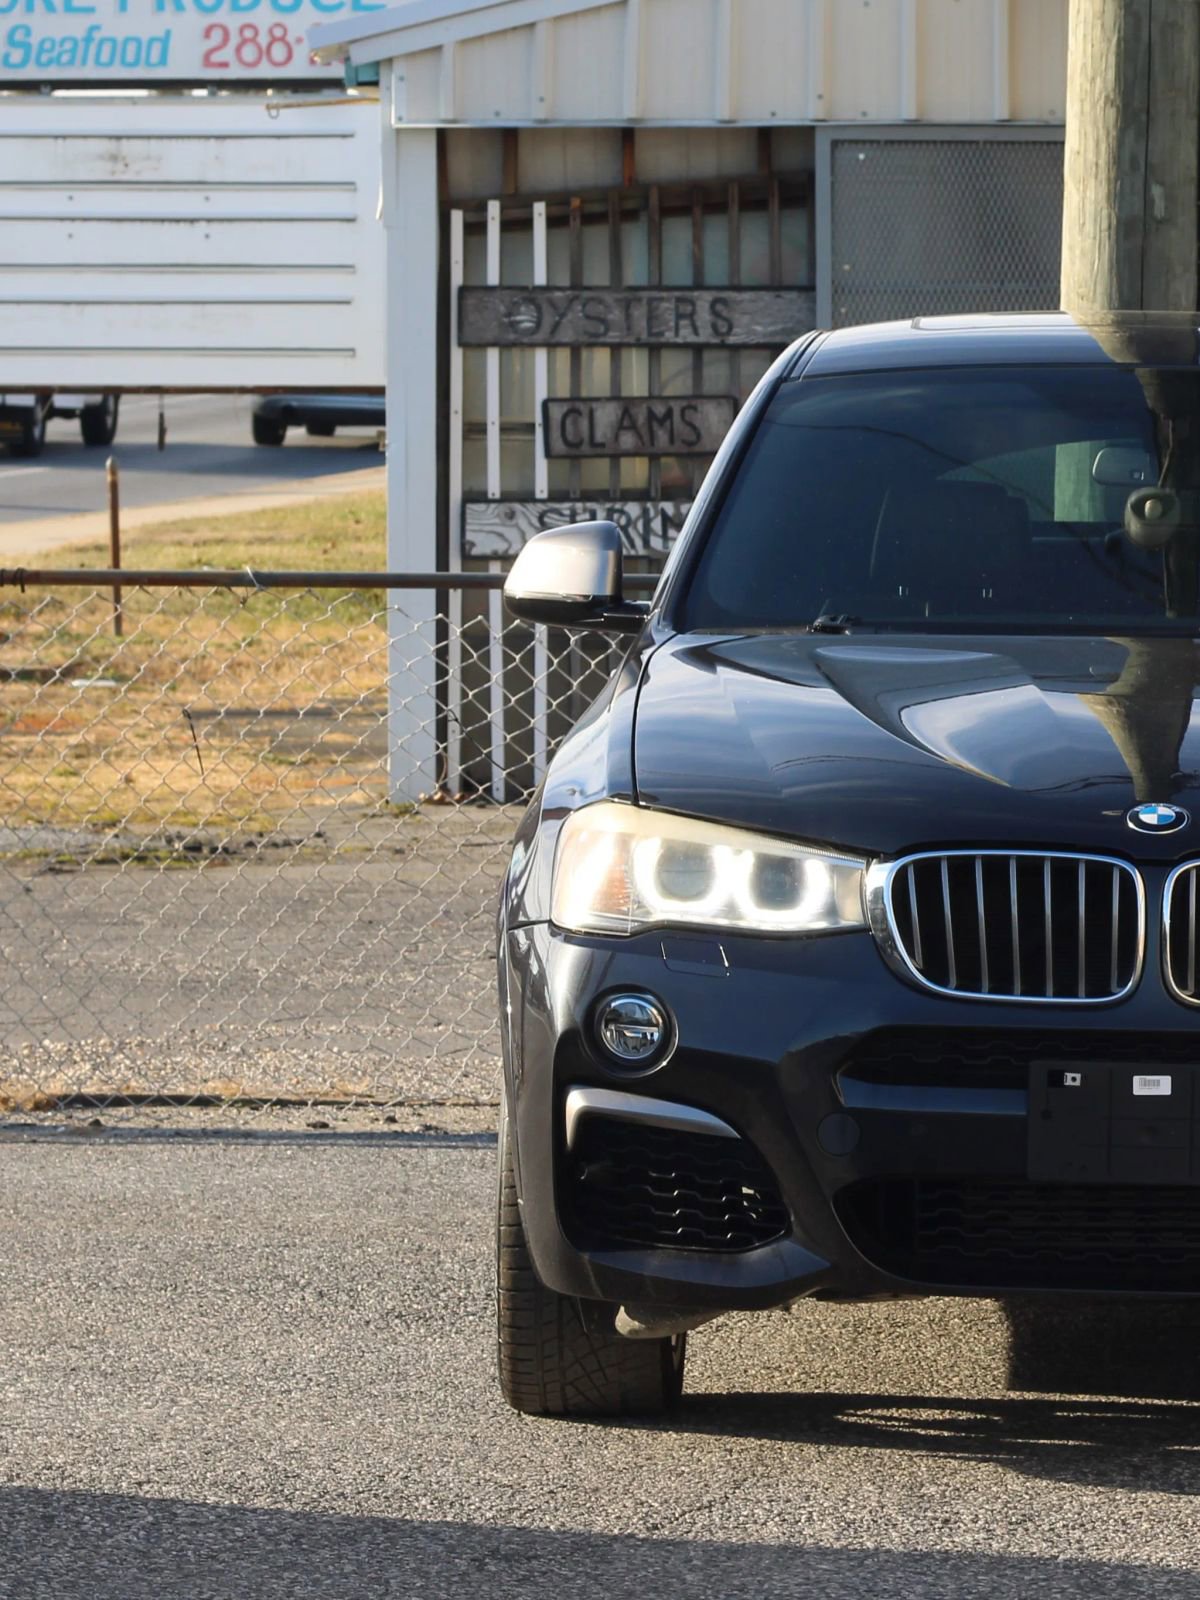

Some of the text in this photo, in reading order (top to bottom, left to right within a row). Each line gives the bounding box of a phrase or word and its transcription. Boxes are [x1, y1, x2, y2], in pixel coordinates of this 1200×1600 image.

[2, 23, 172, 69] Seafood
[507, 293, 735, 338] OYSTERS
[559, 404, 703, 449] CLAMS
